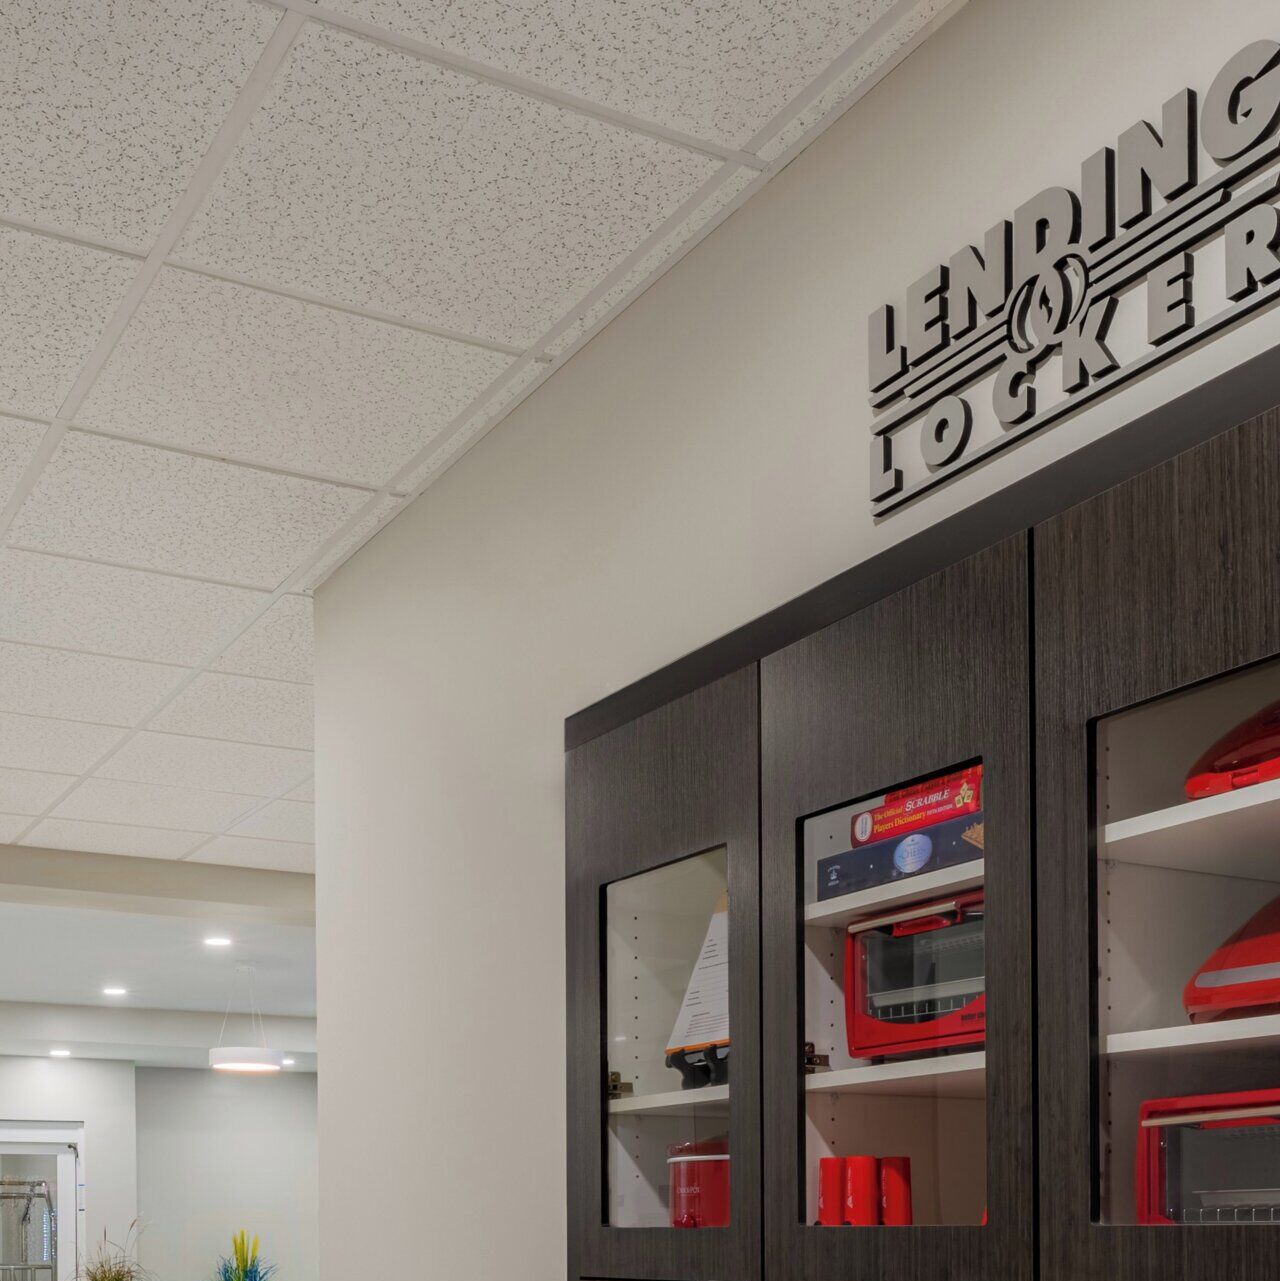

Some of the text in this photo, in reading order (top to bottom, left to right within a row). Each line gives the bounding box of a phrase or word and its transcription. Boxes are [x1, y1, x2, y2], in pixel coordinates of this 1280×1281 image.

[905, 789, 950, 811] SCRABBLE
[874, 820, 894, 834] Players
[894, 811, 926, 827] Dictionary
